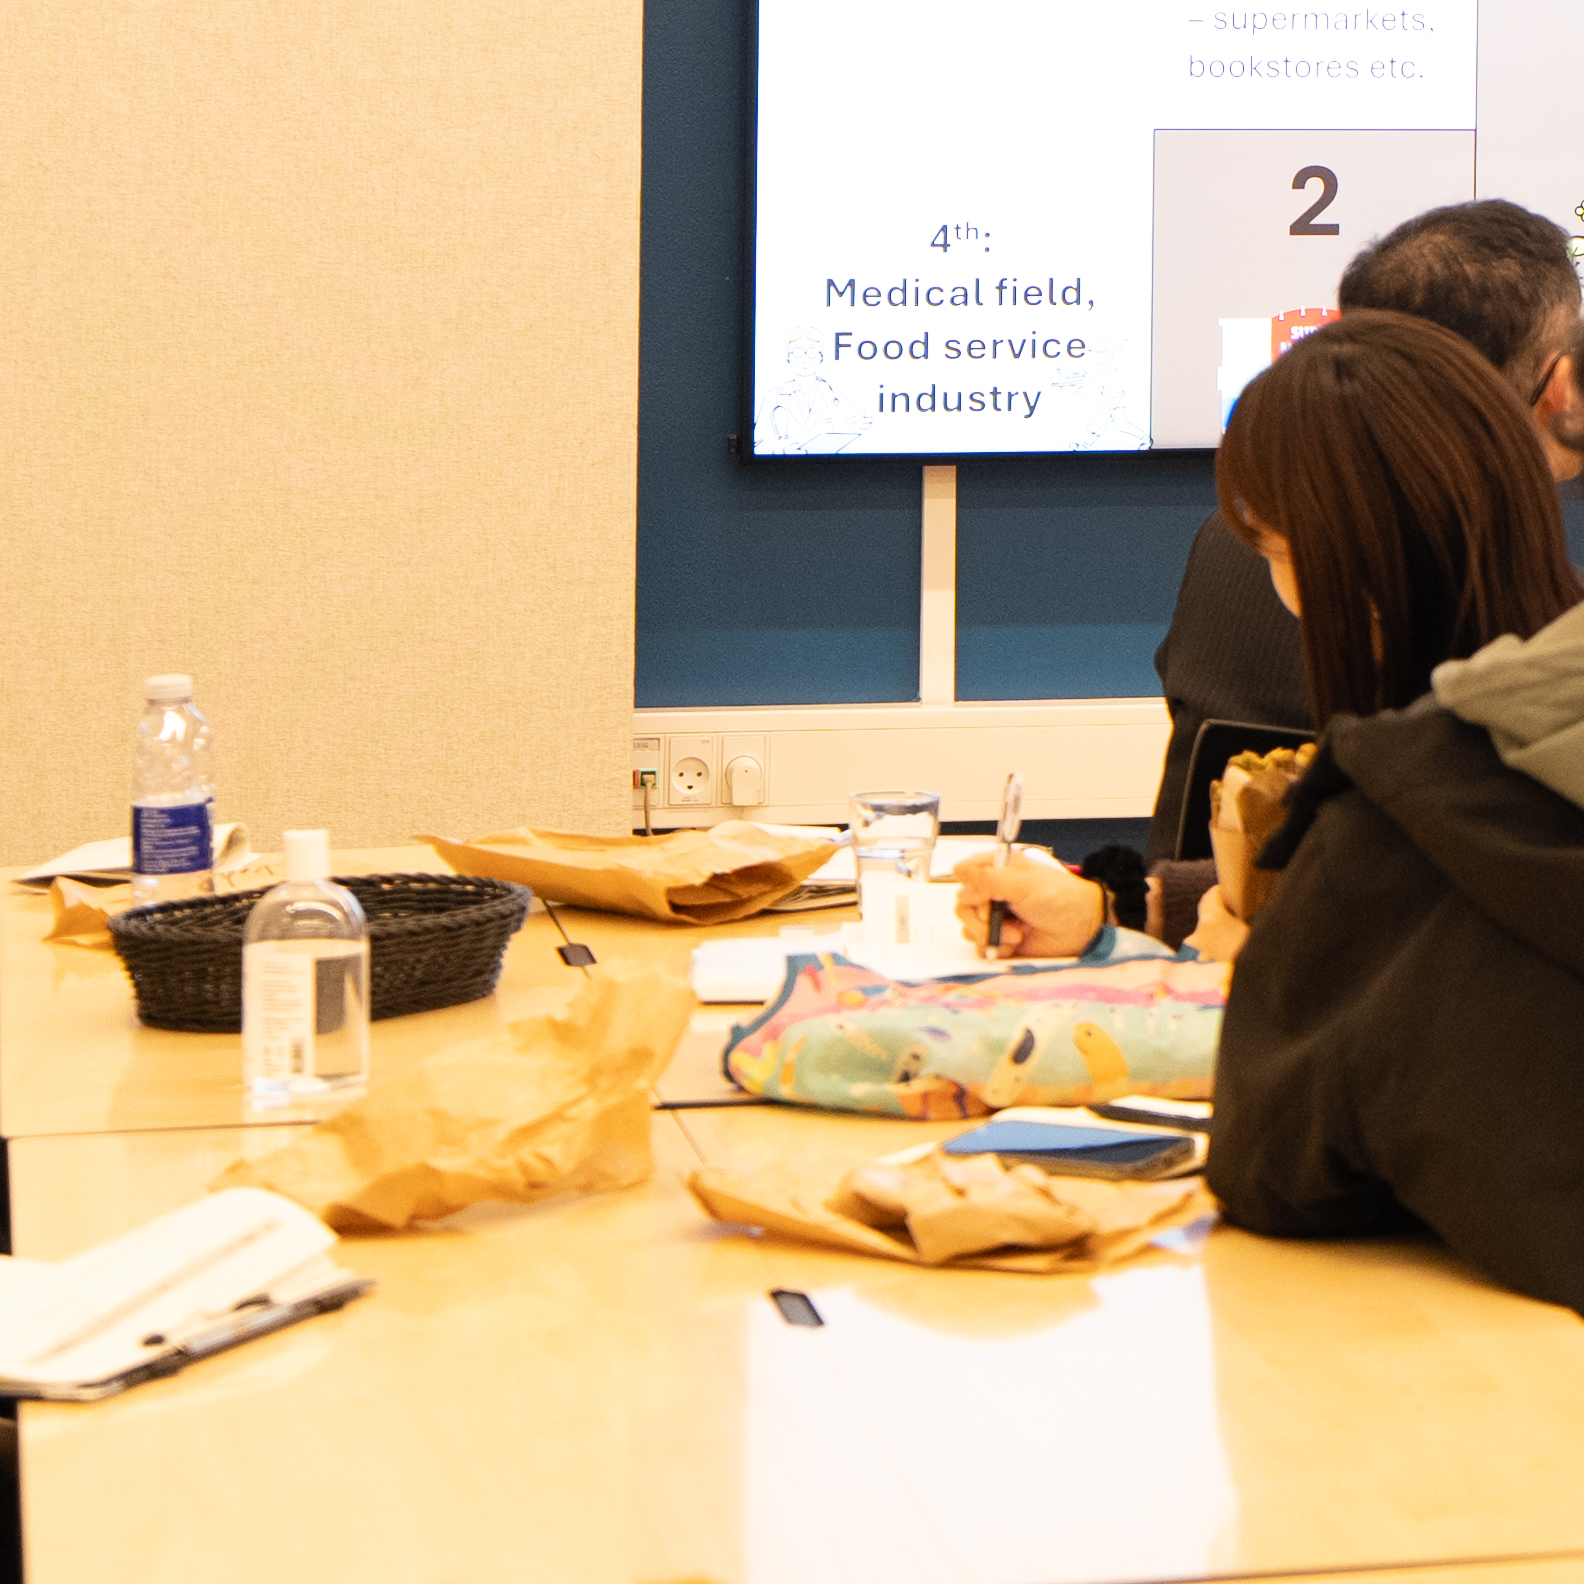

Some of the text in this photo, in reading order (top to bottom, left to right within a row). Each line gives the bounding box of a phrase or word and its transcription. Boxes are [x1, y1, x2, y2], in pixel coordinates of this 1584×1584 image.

[1215, 9, 1433, 35] supermarkets,
[1190, 55, 1422, 78] bookstores etc.
[1289, 166, 1339, 236] 2
[826, 277, 1094, 311] Medical field,
[835, 331, 1086, 360] Food service
[879, 384, 1041, 419] industry
